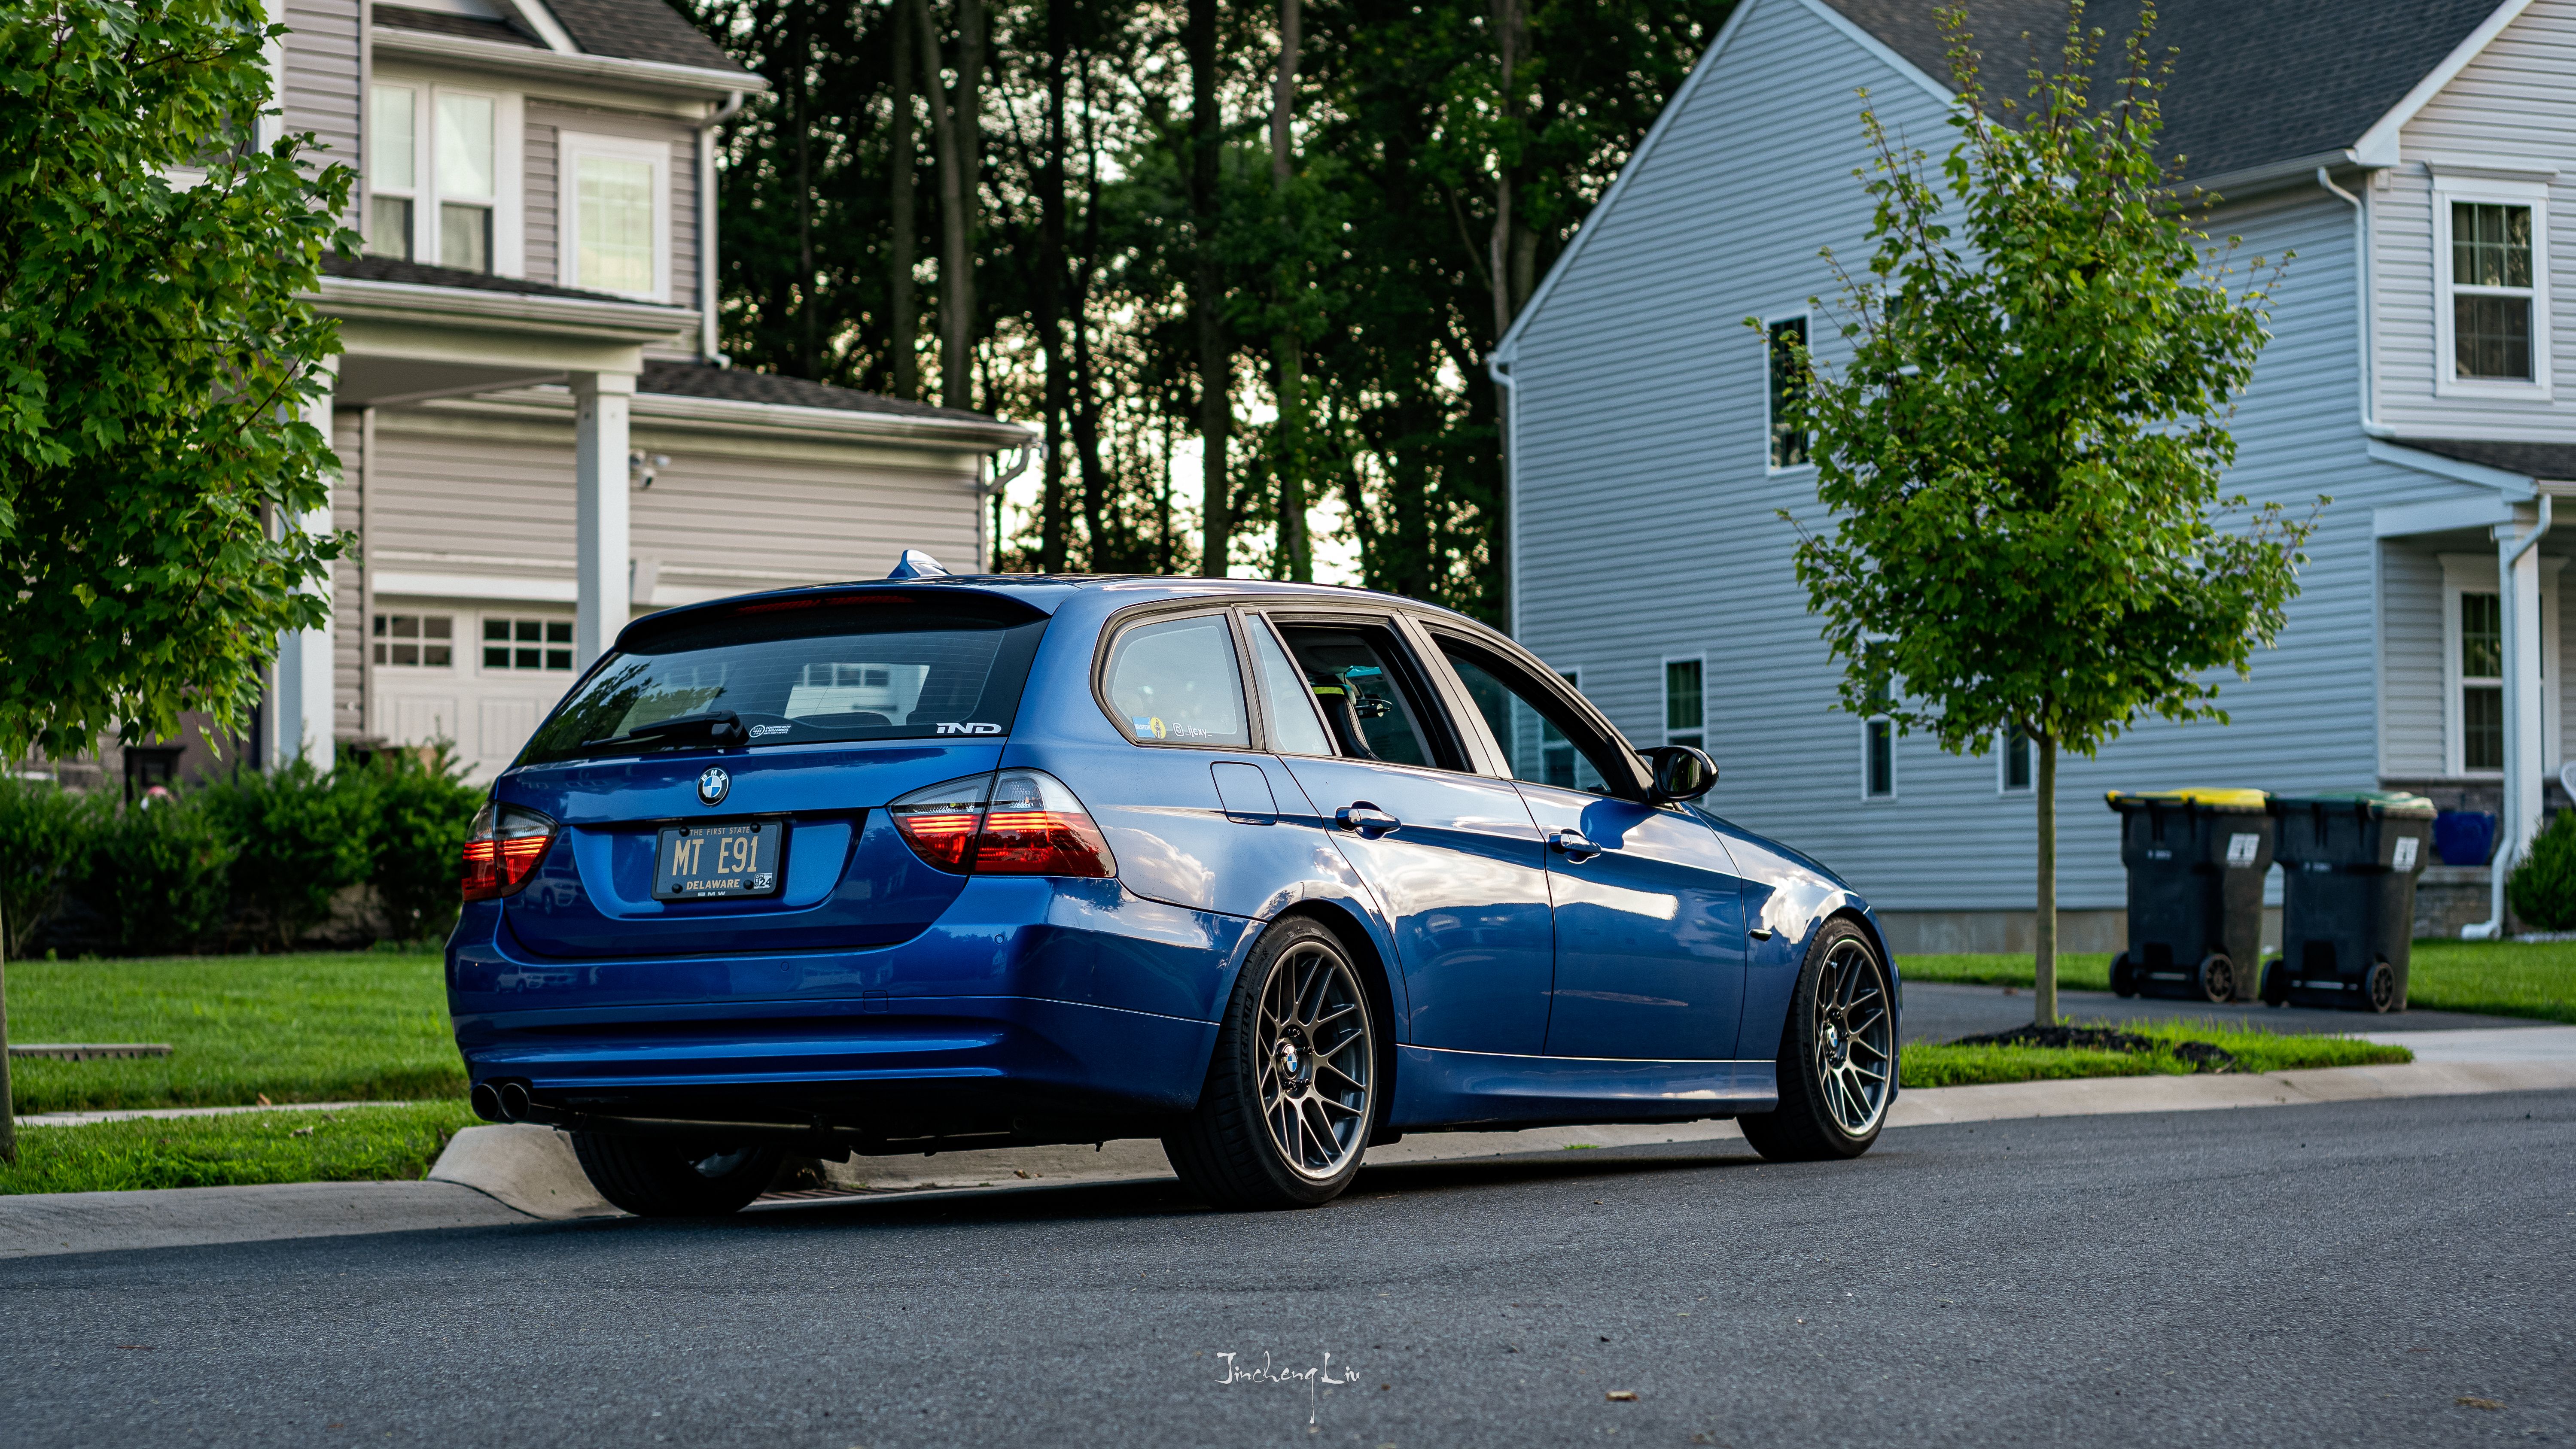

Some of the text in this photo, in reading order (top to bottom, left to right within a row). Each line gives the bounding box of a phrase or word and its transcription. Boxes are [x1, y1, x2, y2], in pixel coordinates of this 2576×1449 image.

[701, 769, 726, 781] BMW
[672, 836, 758, 876] MT E91
[686, 879, 740, 890] DELAWARE
[759, 878, 772, 887] 24
[1242, 997, 1253, 1075] MICHELIN
